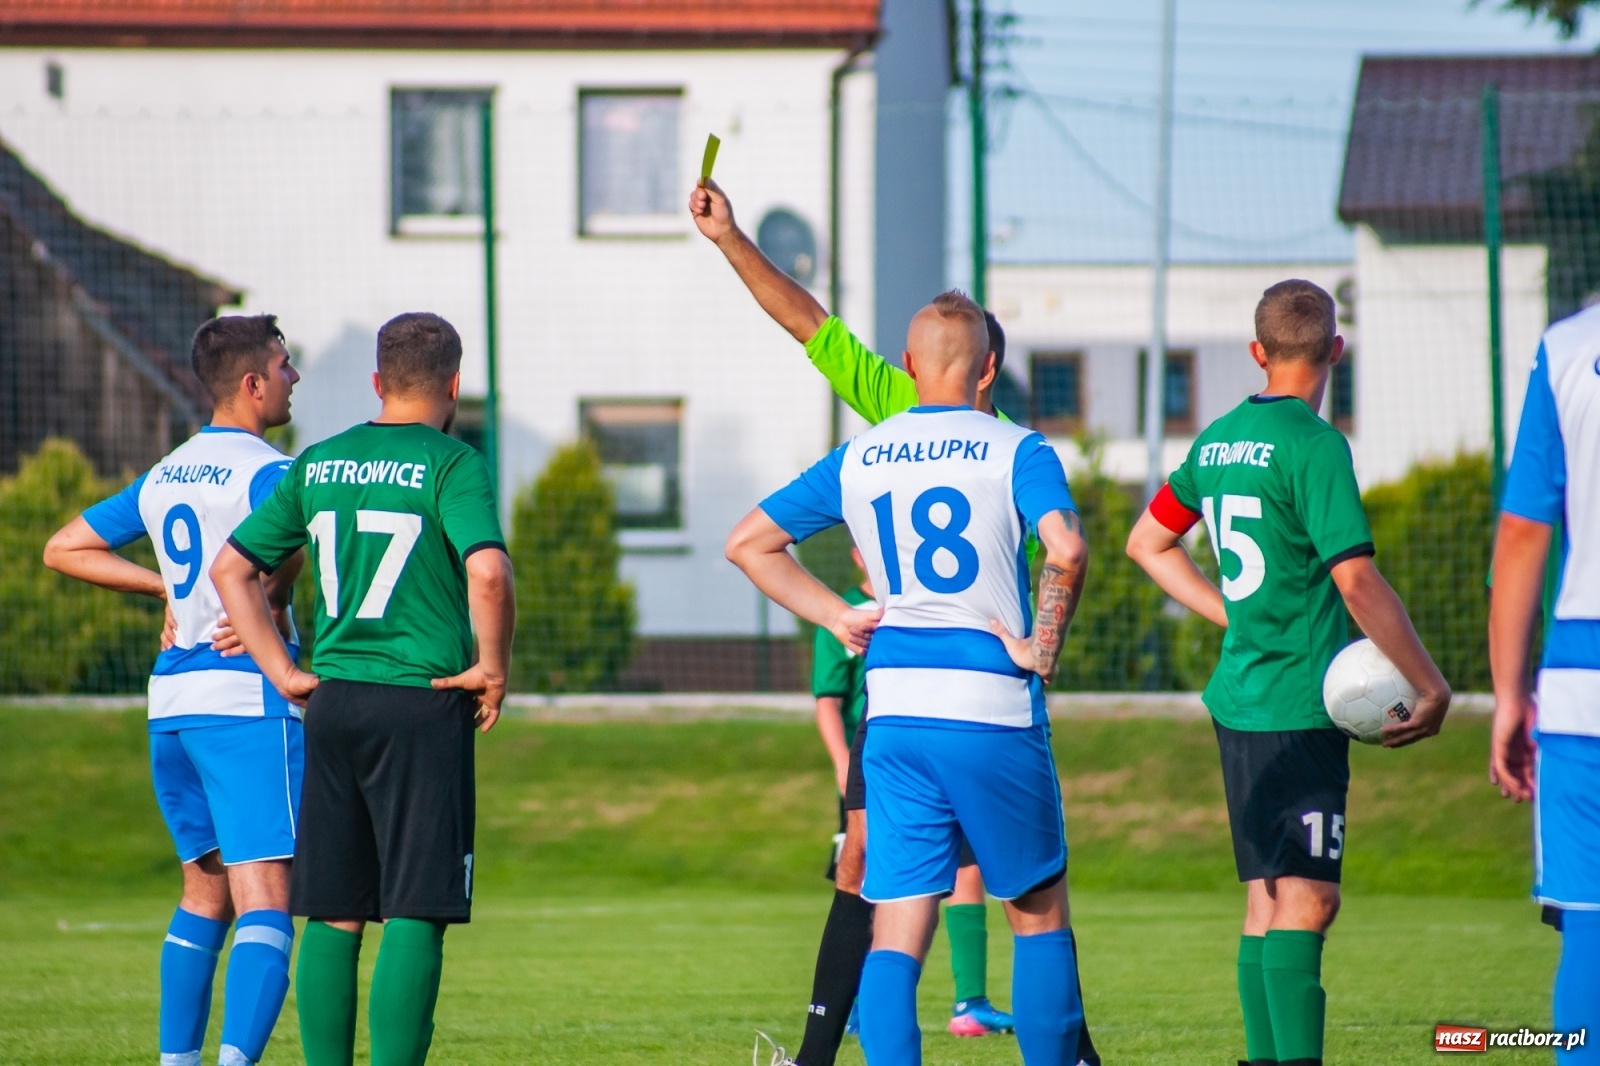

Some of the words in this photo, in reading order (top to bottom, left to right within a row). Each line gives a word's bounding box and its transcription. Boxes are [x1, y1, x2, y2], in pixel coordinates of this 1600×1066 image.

[305, 459, 427, 489] PIETROWICE
[862, 439, 989, 467] CHAŁUPKI
[163, 503, 202, 599] 9
[306, 509, 423, 619] 17
[870, 486, 980, 595] 18
[1201, 494, 1266, 602] 15
